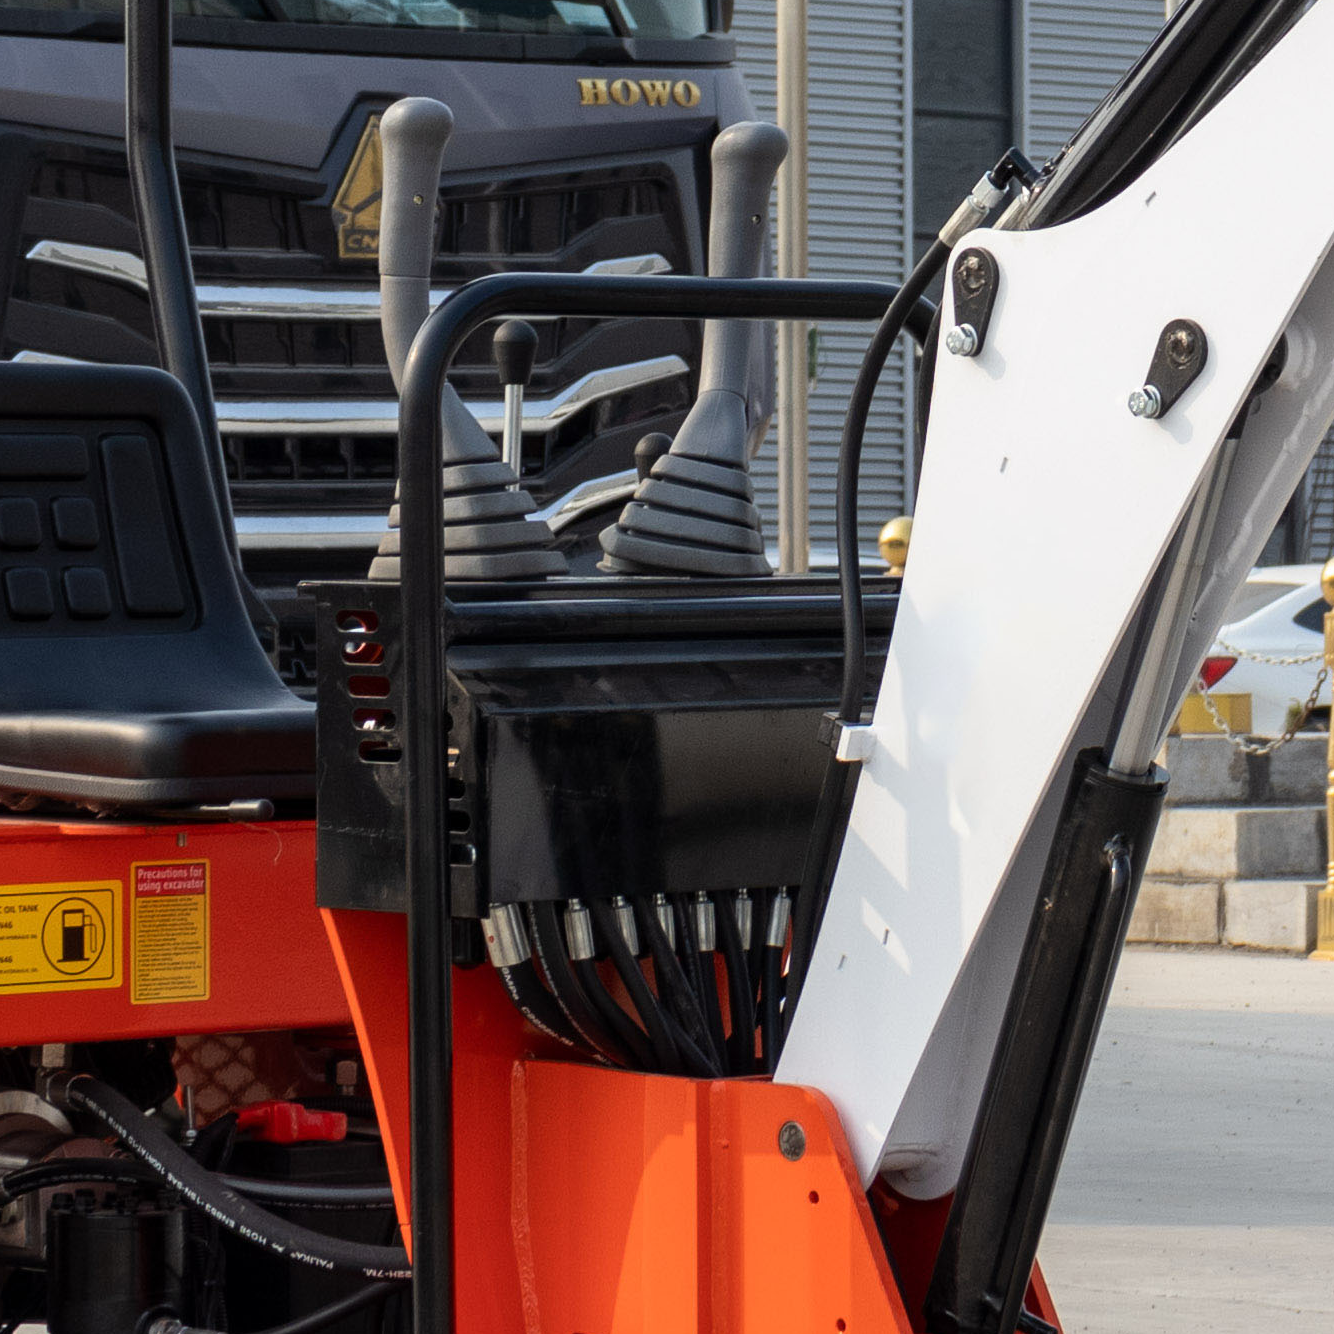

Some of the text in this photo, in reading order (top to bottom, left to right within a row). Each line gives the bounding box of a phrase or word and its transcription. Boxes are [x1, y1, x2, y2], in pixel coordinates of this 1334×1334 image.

[577, 78, 702, 107] HOWO
[138, 865, 203, 880] Precautions for
[137, 878, 204, 894] using excavator
[4, 905, 15, 914] OIL
[18, 904, 39, 913] TANK
